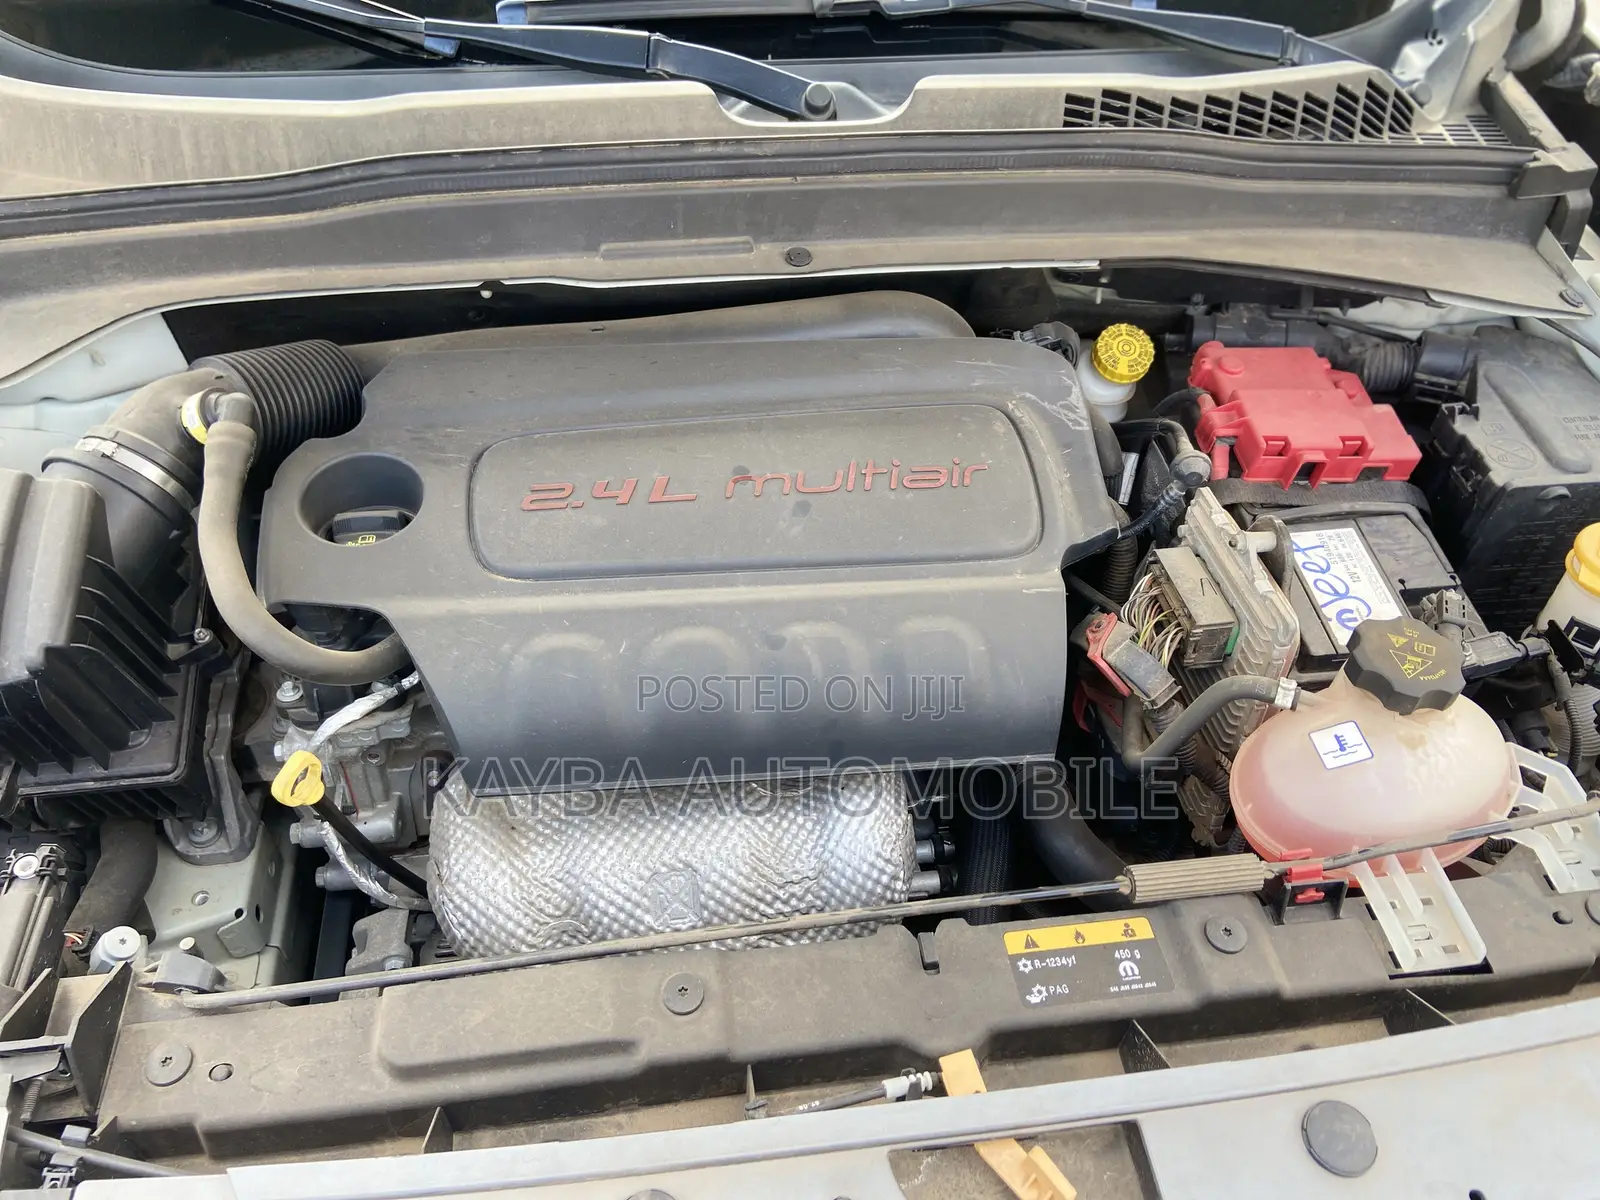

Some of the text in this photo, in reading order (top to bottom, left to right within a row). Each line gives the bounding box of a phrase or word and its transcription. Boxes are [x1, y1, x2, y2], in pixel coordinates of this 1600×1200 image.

[725, 457, 989, 498] multiair
[1114, 949, 1131, 959] 450
[1134, 949, 1142, 960] g
[1049, 983, 1070, 995] PAG
